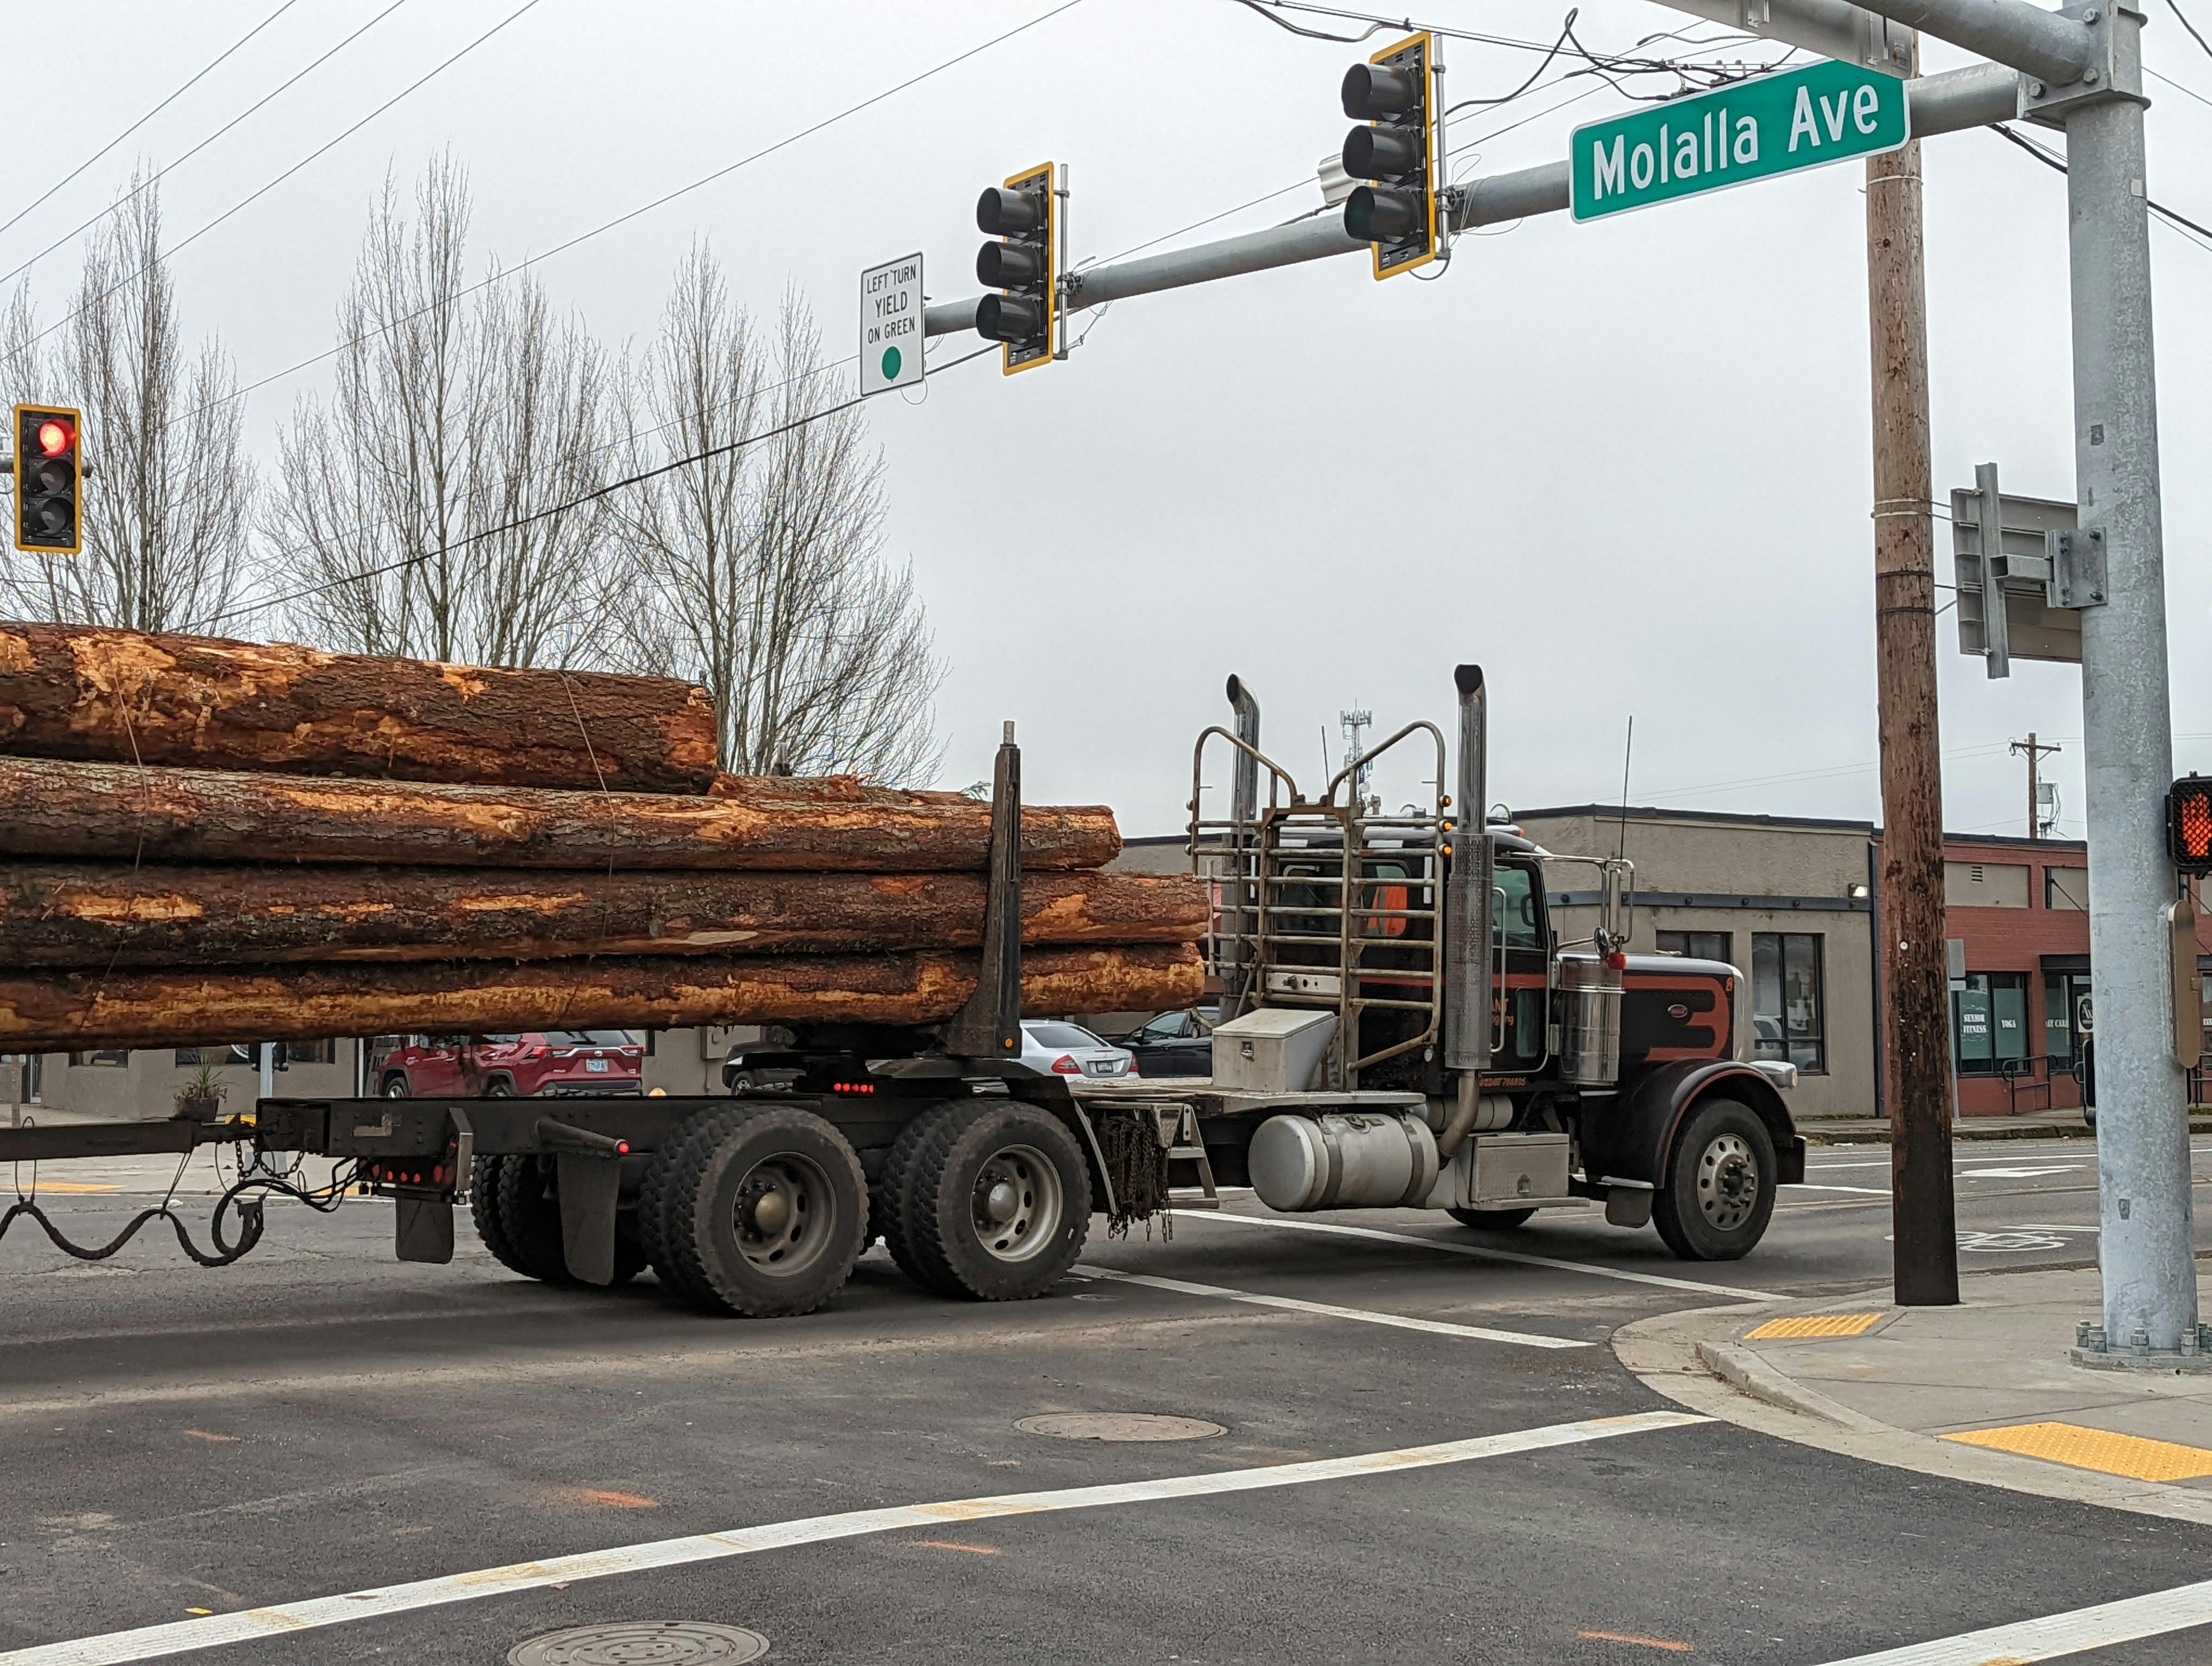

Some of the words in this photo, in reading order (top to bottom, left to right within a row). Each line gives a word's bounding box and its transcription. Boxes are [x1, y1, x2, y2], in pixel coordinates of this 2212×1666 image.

[1593, 107, 1759, 200] Molalla
[1788, 84, 1879, 152] Ave
[867, 273, 889, 294] LEFT
[890, 264, 916, 286] TURN
[875, 291, 908, 318] YIELD
[867, 326, 880, 344] ON
[884, 316, 915, 339] GREEN
[1963, 1025, 1987, 1034] FITNESS
